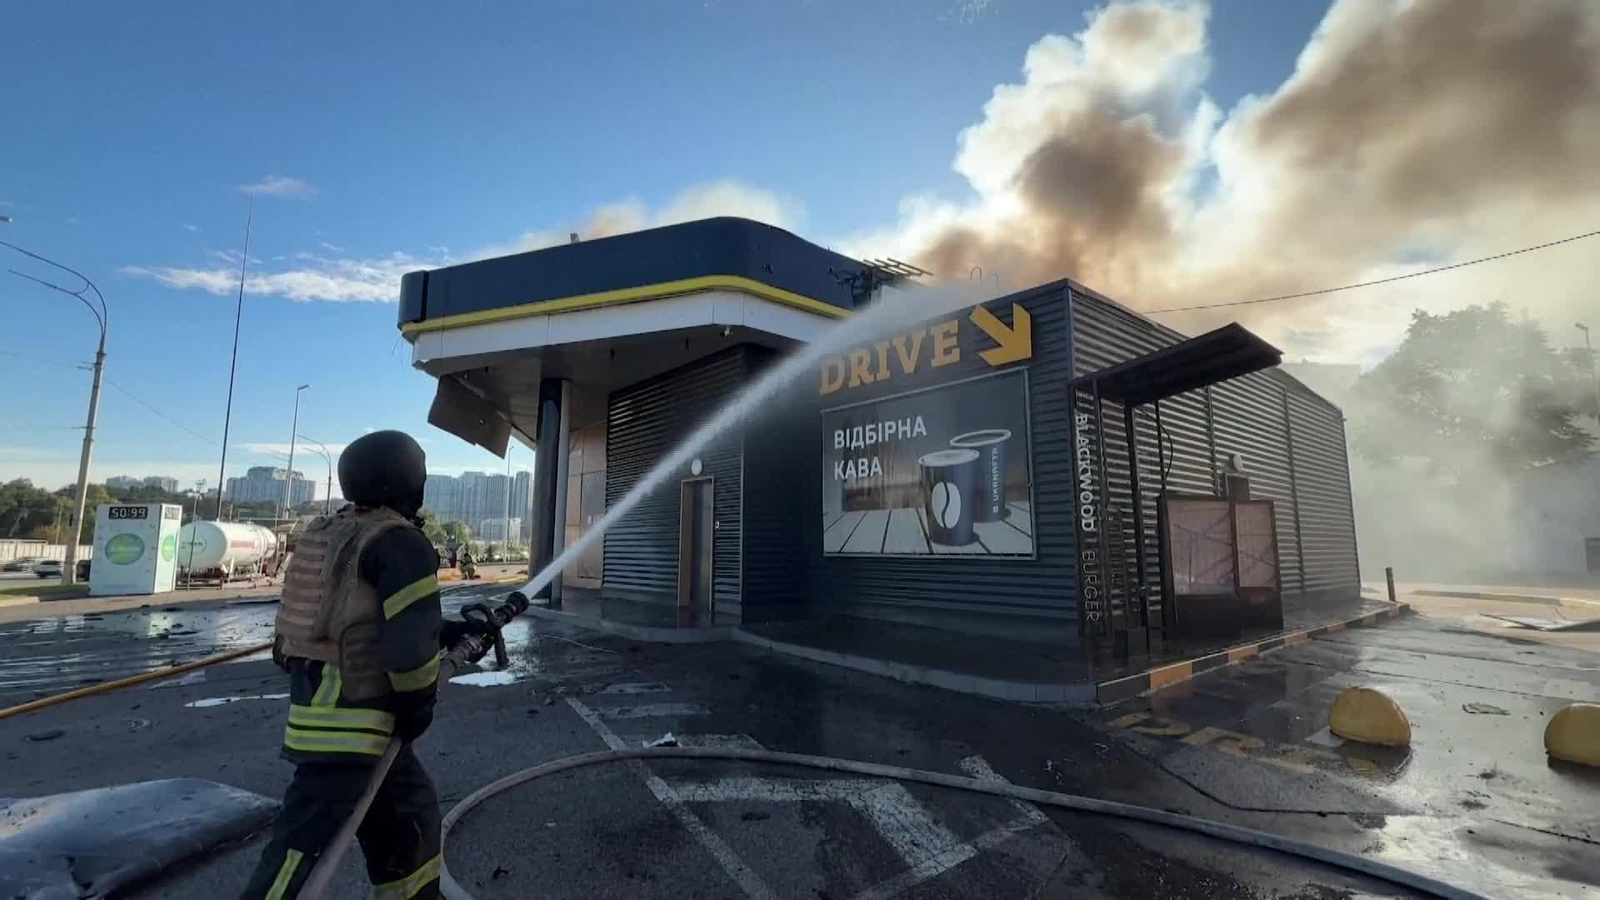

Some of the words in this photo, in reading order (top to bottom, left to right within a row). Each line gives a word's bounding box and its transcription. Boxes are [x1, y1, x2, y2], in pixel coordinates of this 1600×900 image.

[819, 320, 961, 395] DRIVE
[833, 415, 927, 450] ВІДБІРНА
[833, 456, 883, 481] КАВА
[1075, 413, 1095, 532] BLACKWOOD
[1081, 551, 1100, 621] BURGER
